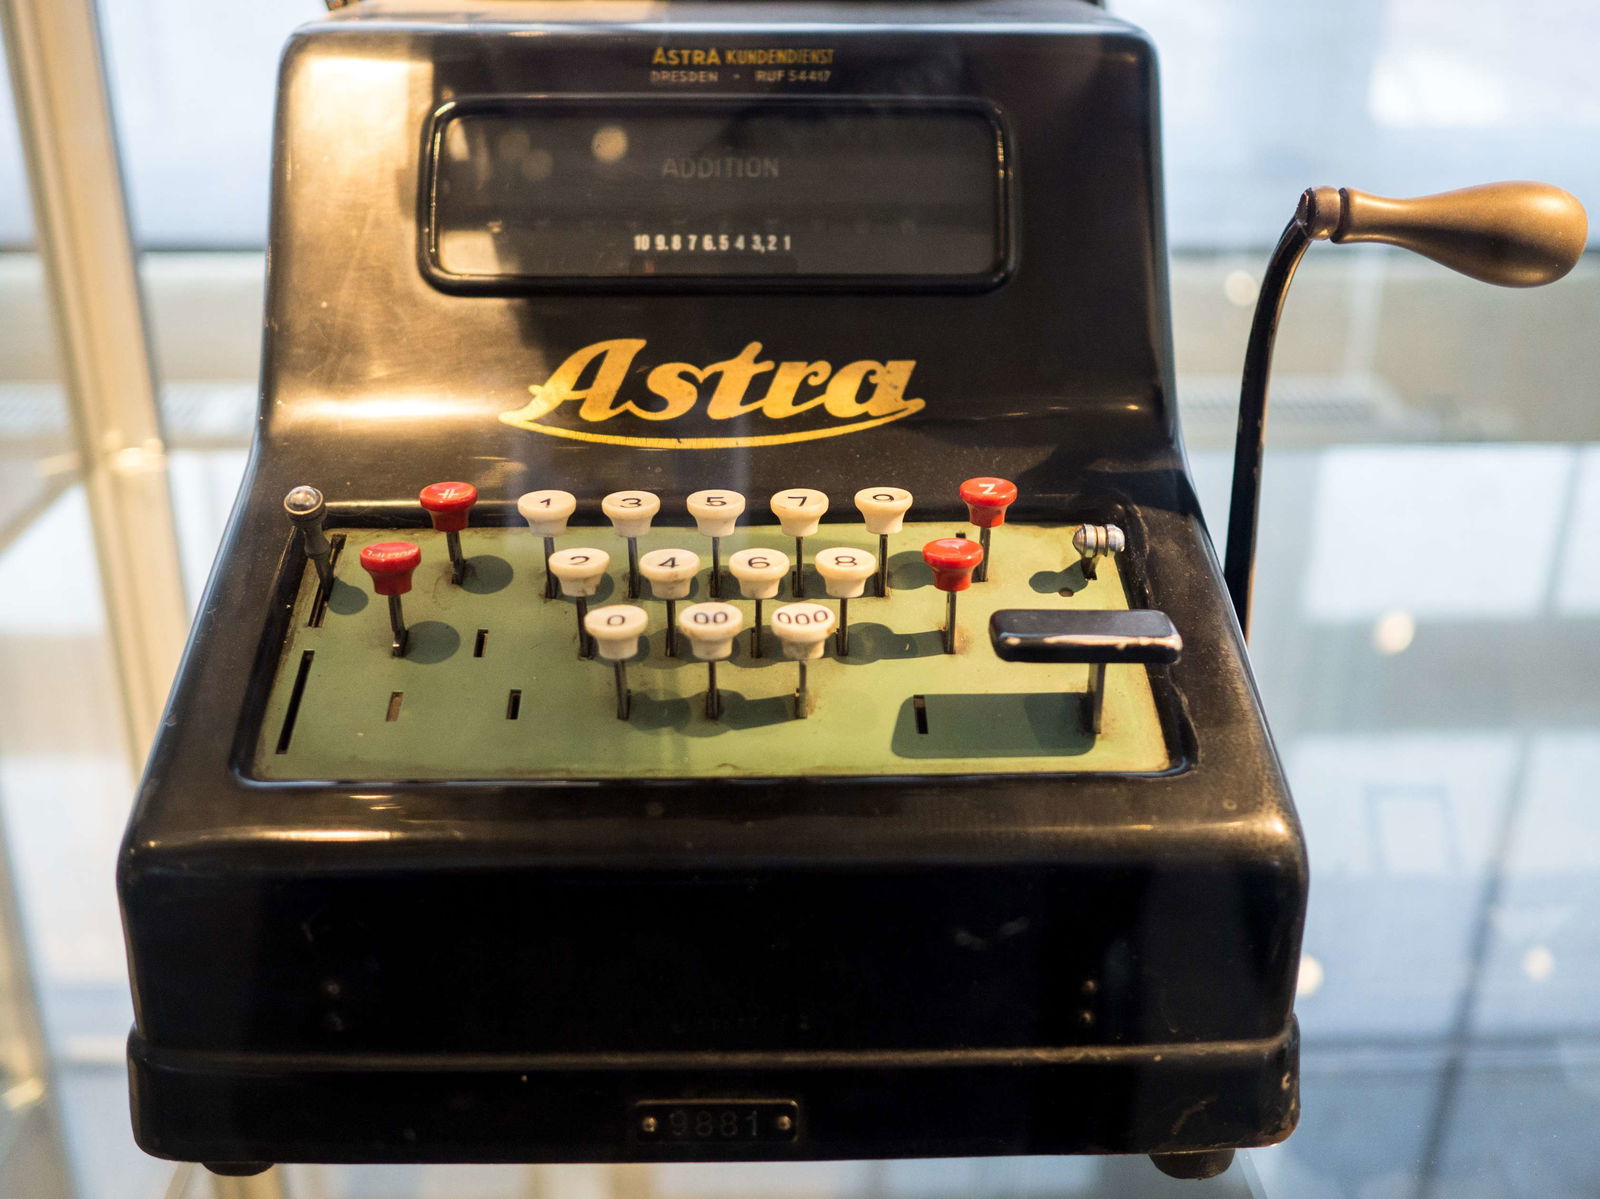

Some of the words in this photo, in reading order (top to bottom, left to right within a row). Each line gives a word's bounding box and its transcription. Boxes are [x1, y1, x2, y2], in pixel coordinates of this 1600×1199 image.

[652, 47, 721, 66] ASTRA
[725, 48, 835, 65] KUNDENDIENST
[650, 70, 719, 83] DRESDEN
[756, 70, 785, 82] RUF
[662, 158, 780, 178] ADDITION
[498, 338, 926, 449] Astra
[978, 483, 998, 496] Z
[541, 498, 552, 507] 1
[621, 497, 642, 509] 3
[706, 496, 727, 507] 5
[787, 496, 808, 507] 7
[569, 555, 590, 566] 2
[657, 556, 680, 568] 4
[748, 556, 770, 569] 6
[834, 555, 857, 567] 8
[606, 614, 626, 626] 0
[692, 611, 729, 625] 00
[777, 609, 829, 625] 000
[670, 1110, 759, 1137] 9881
